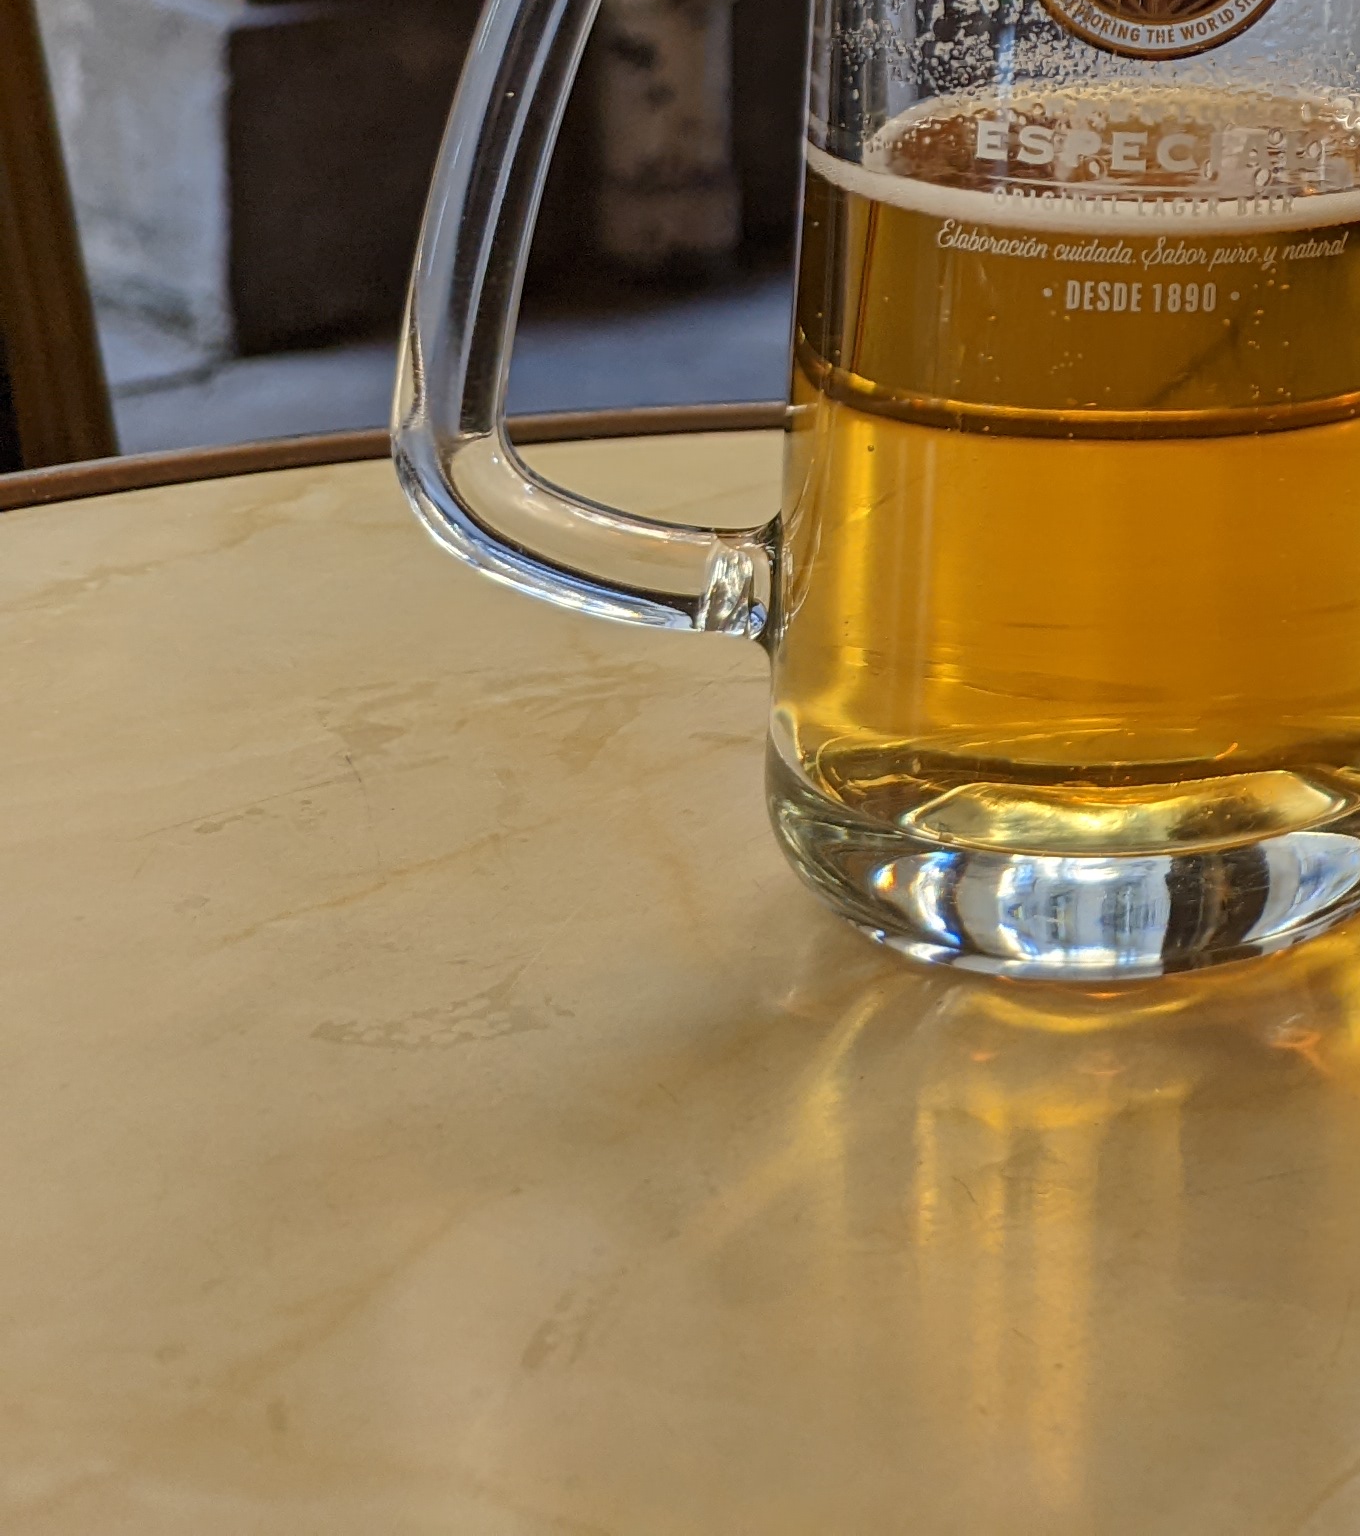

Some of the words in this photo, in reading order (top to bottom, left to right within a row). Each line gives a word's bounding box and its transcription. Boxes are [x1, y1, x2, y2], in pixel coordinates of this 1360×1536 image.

[1146, 28, 1176, 44] THE
[1179, 8, 1236, 41] WORLD
[992, 185, 1121, 216] ORIGINAL
[1137, 194, 1221, 217] LAGER
[1237, 193, 1295, 217] BEER
[936, 217, 1049, 260] Elaboración
[1053, 238, 1137, 264] cuidada.
[1141, 235, 1208, 271] Sabor
[1281, 230, 1350, 261] natural
[1065, 279, 1142, 312] DESDE
[1152, 280, 1217, 313] 1890
